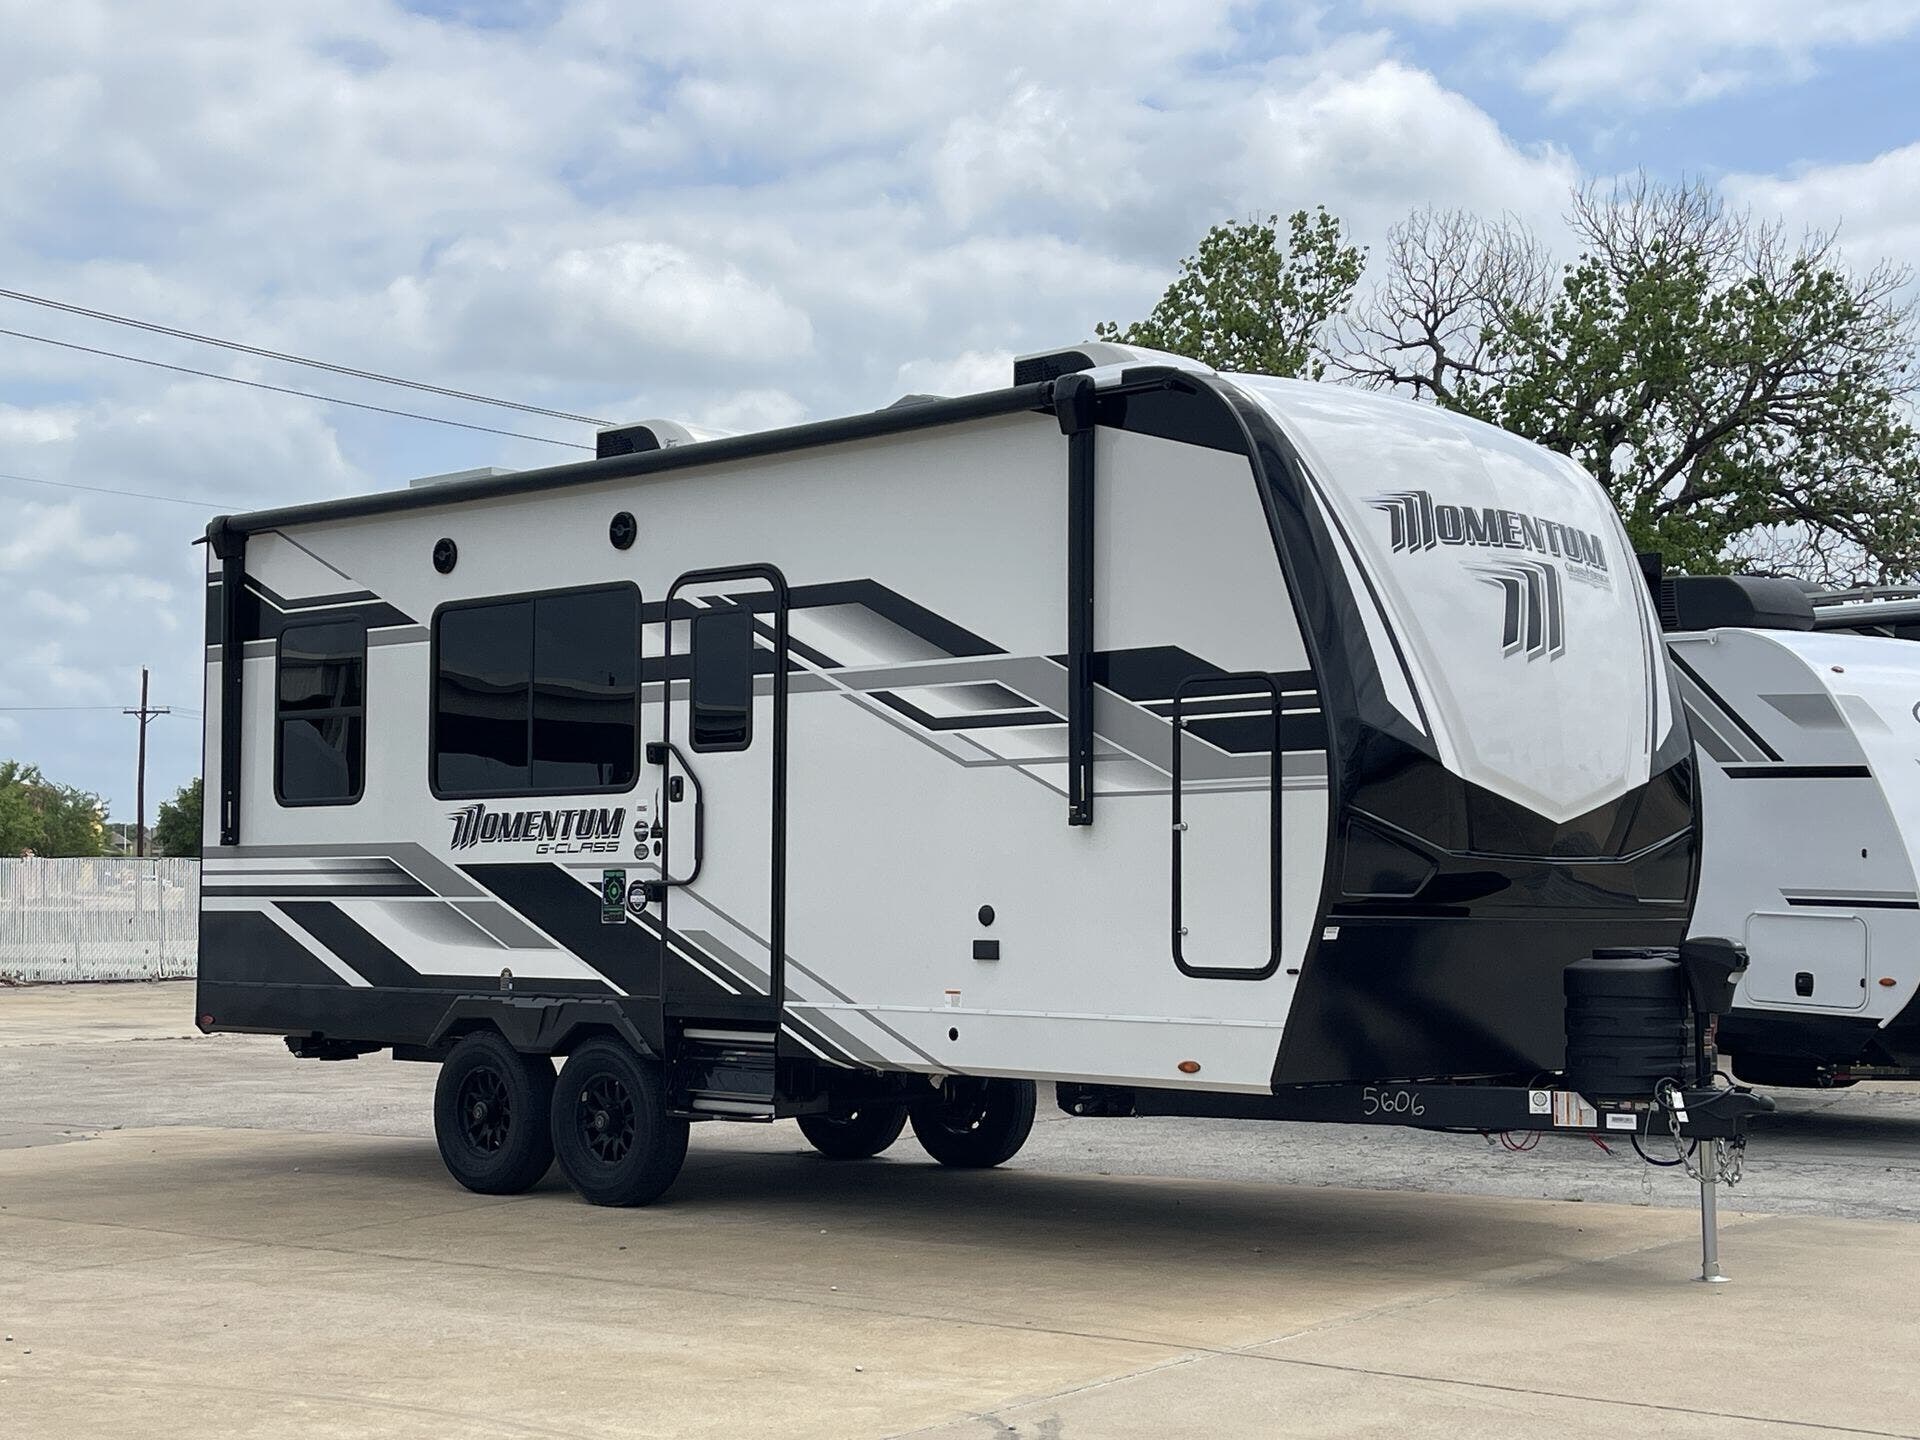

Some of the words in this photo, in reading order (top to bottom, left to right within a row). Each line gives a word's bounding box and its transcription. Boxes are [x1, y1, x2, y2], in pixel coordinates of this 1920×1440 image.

[1361, 490, 1609, 572] MOMENTUM
[446, 803, 626, 850] MOMENTUM
[536, 841, 620, 855] G-CLASS
[1362, 1086, 1425, 1116] 5606
